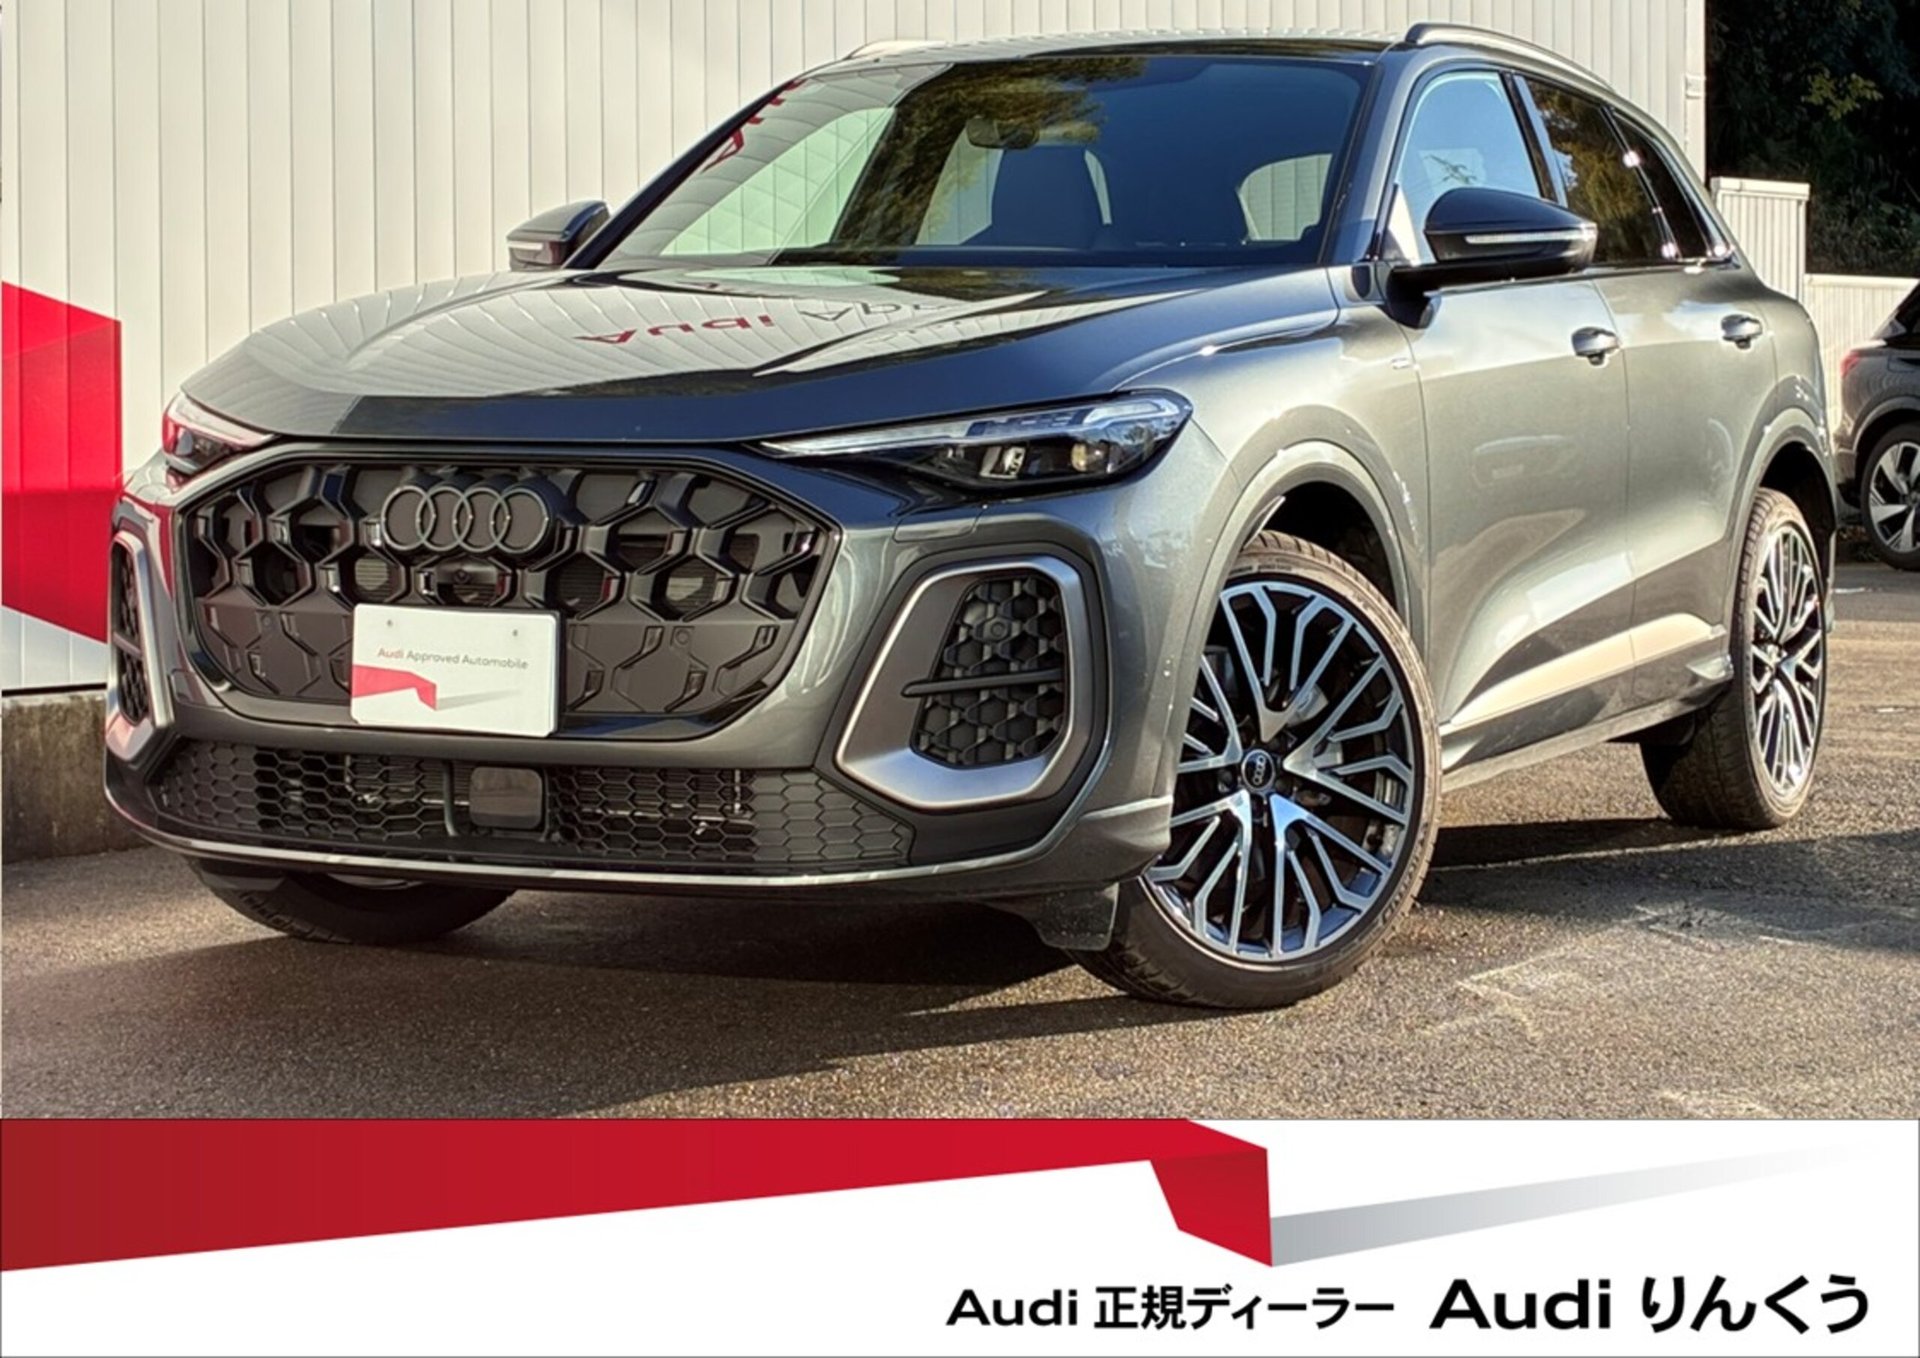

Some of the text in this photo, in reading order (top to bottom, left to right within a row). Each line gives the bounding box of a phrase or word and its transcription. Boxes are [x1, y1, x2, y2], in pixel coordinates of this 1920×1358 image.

[377, 647, 529, 670] Audi Approved Automobile
